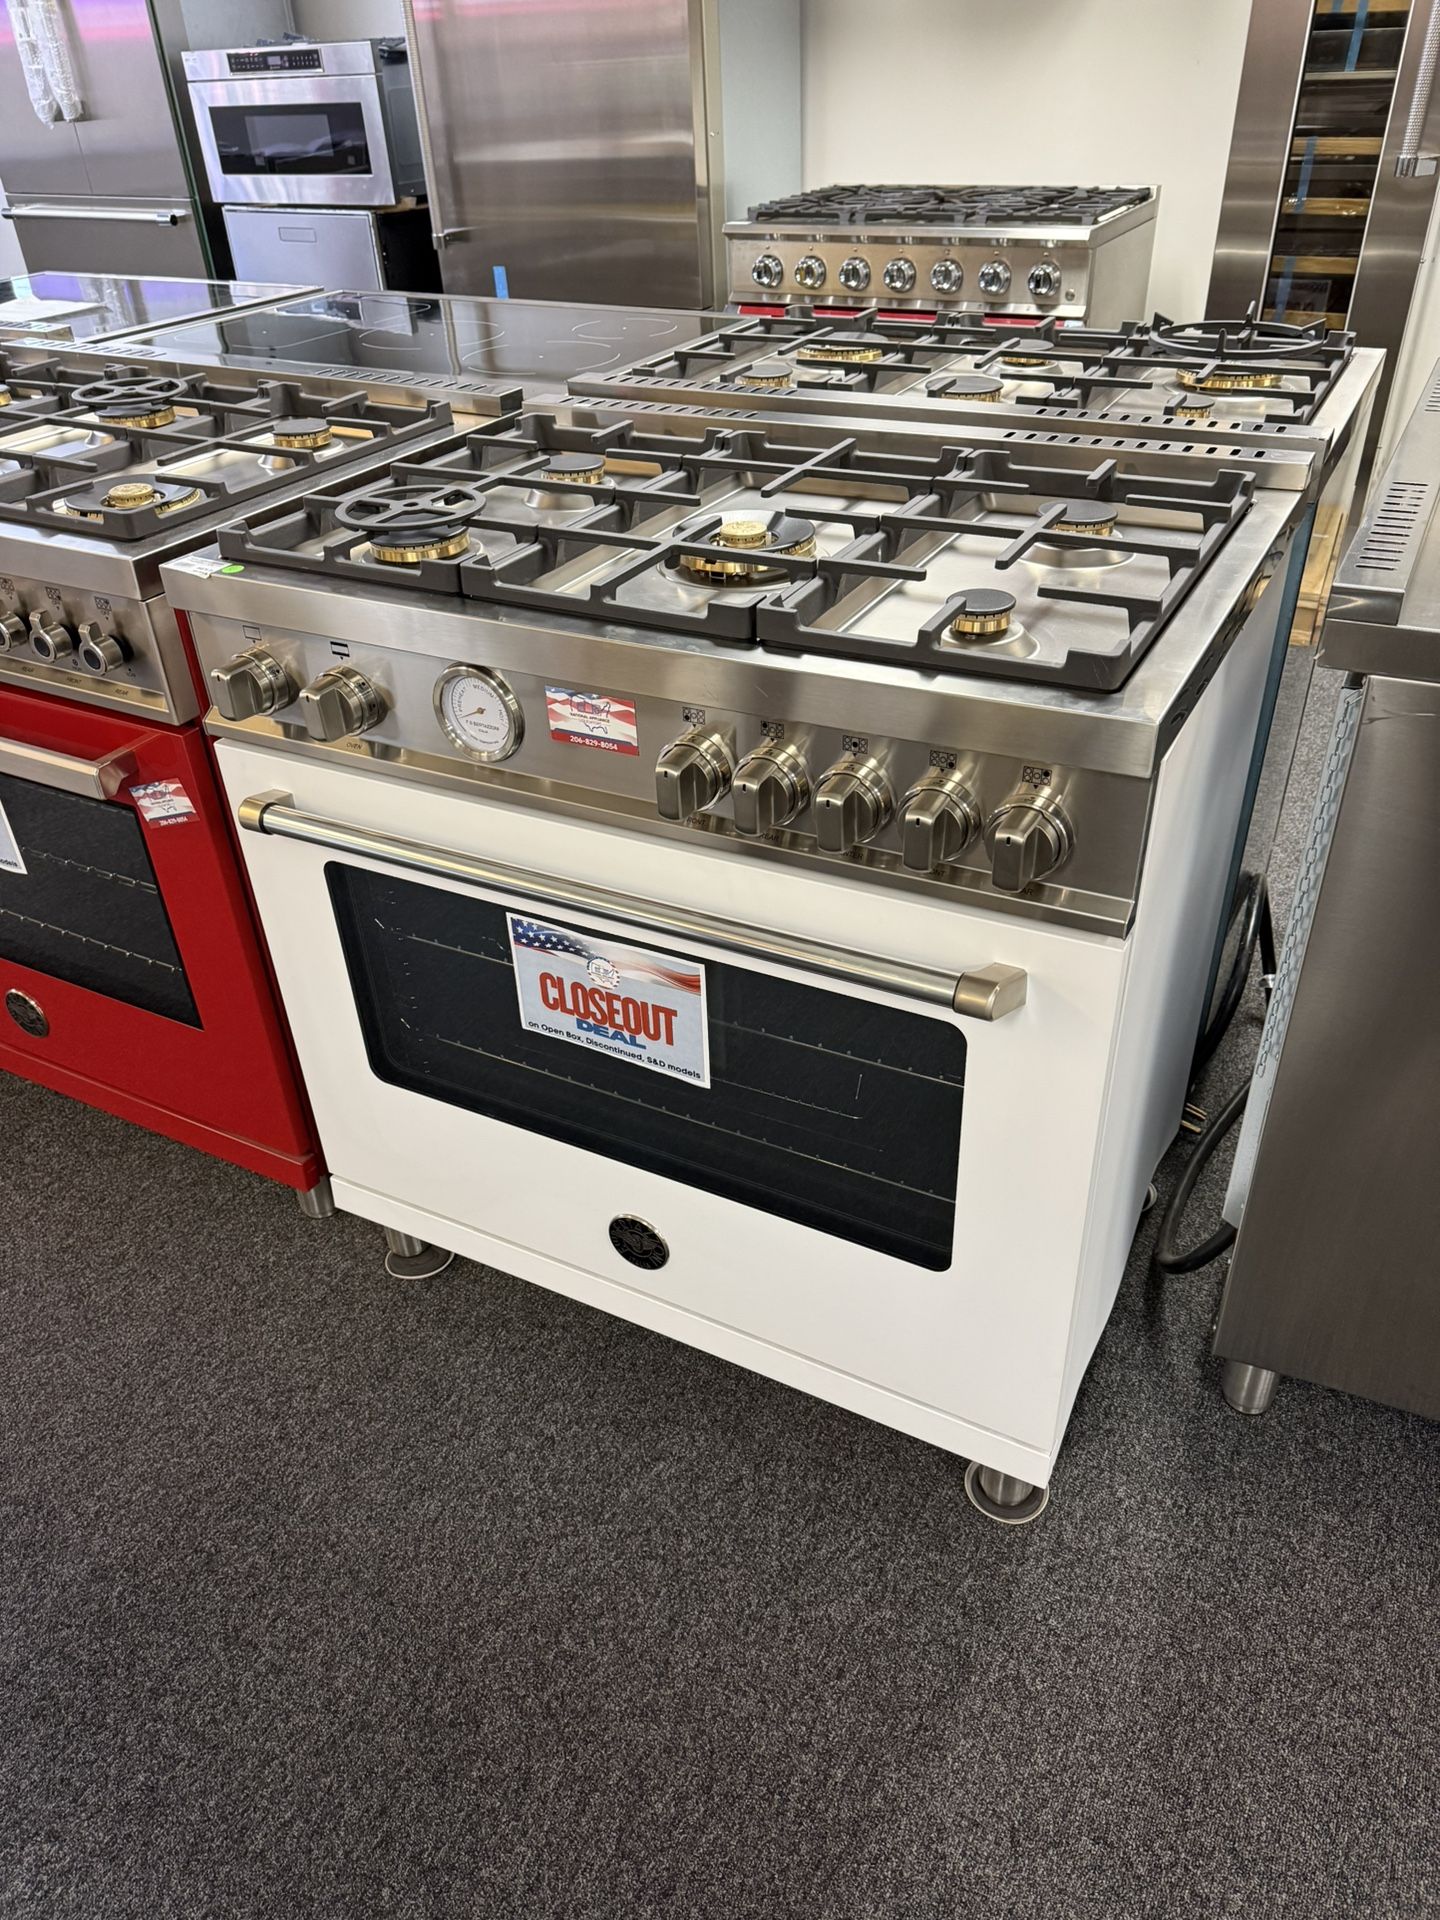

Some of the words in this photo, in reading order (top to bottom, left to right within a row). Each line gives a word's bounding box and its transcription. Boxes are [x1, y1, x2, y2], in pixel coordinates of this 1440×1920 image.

[569, 735, 618, 751] 206-829-8054
[539, 971, 678, 1046] CLOSEOUT
[528, 1021, 540, 1029] on
[541, 1023, 565, 1036] Open
[565, 1031, 585, 1043] Box,
[585, 1036, 645, 1062] Discontinued,
[646, 1056, 666, 1068] S&D
[667, 1063, 701, 1079] models
[575, 1017, 647, 1050] DEAL
